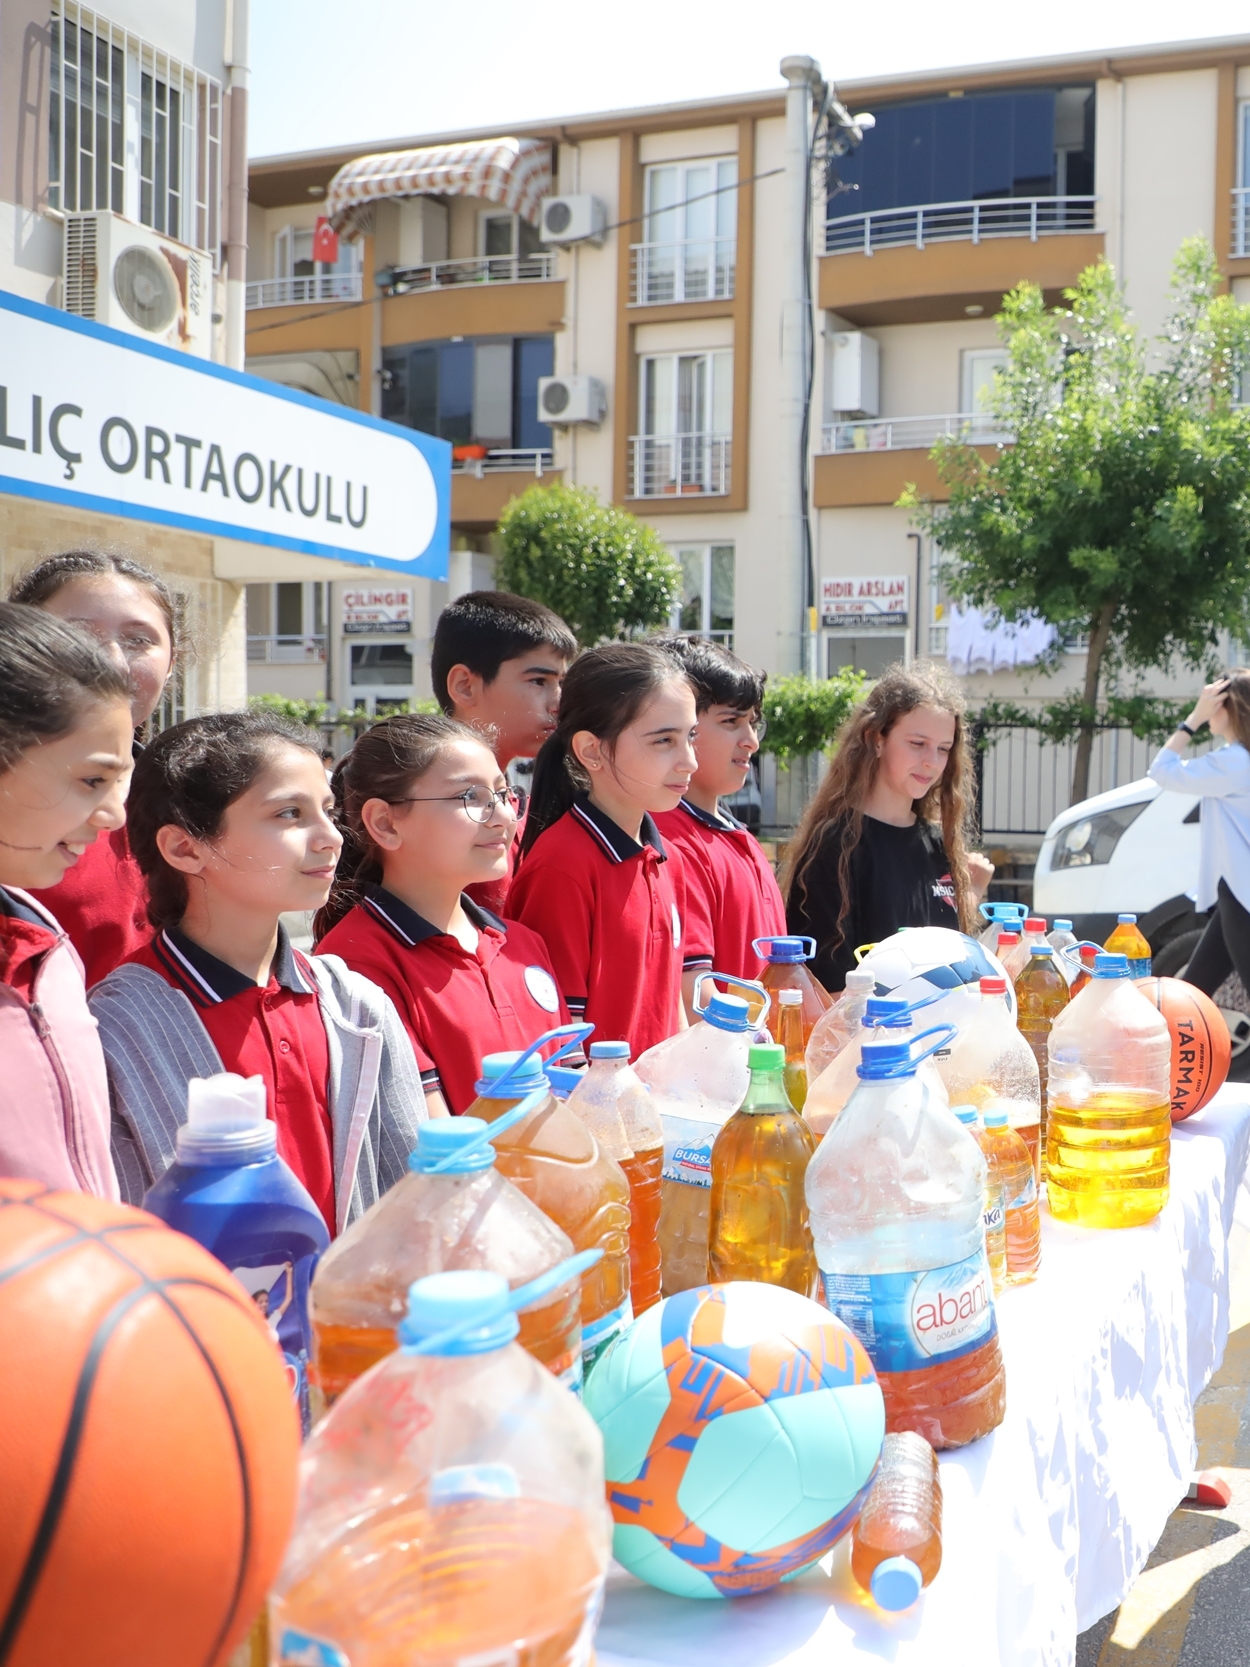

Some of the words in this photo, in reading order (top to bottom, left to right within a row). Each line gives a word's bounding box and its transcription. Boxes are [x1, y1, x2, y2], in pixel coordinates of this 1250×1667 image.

[100, 416, 368, 529] ORTAOKULU
[824, 581, 853, 598] HIDIR
[858, 579, 905, 596] ARSLAN
[1171, 1019, 1195, 1111] TARMAK
